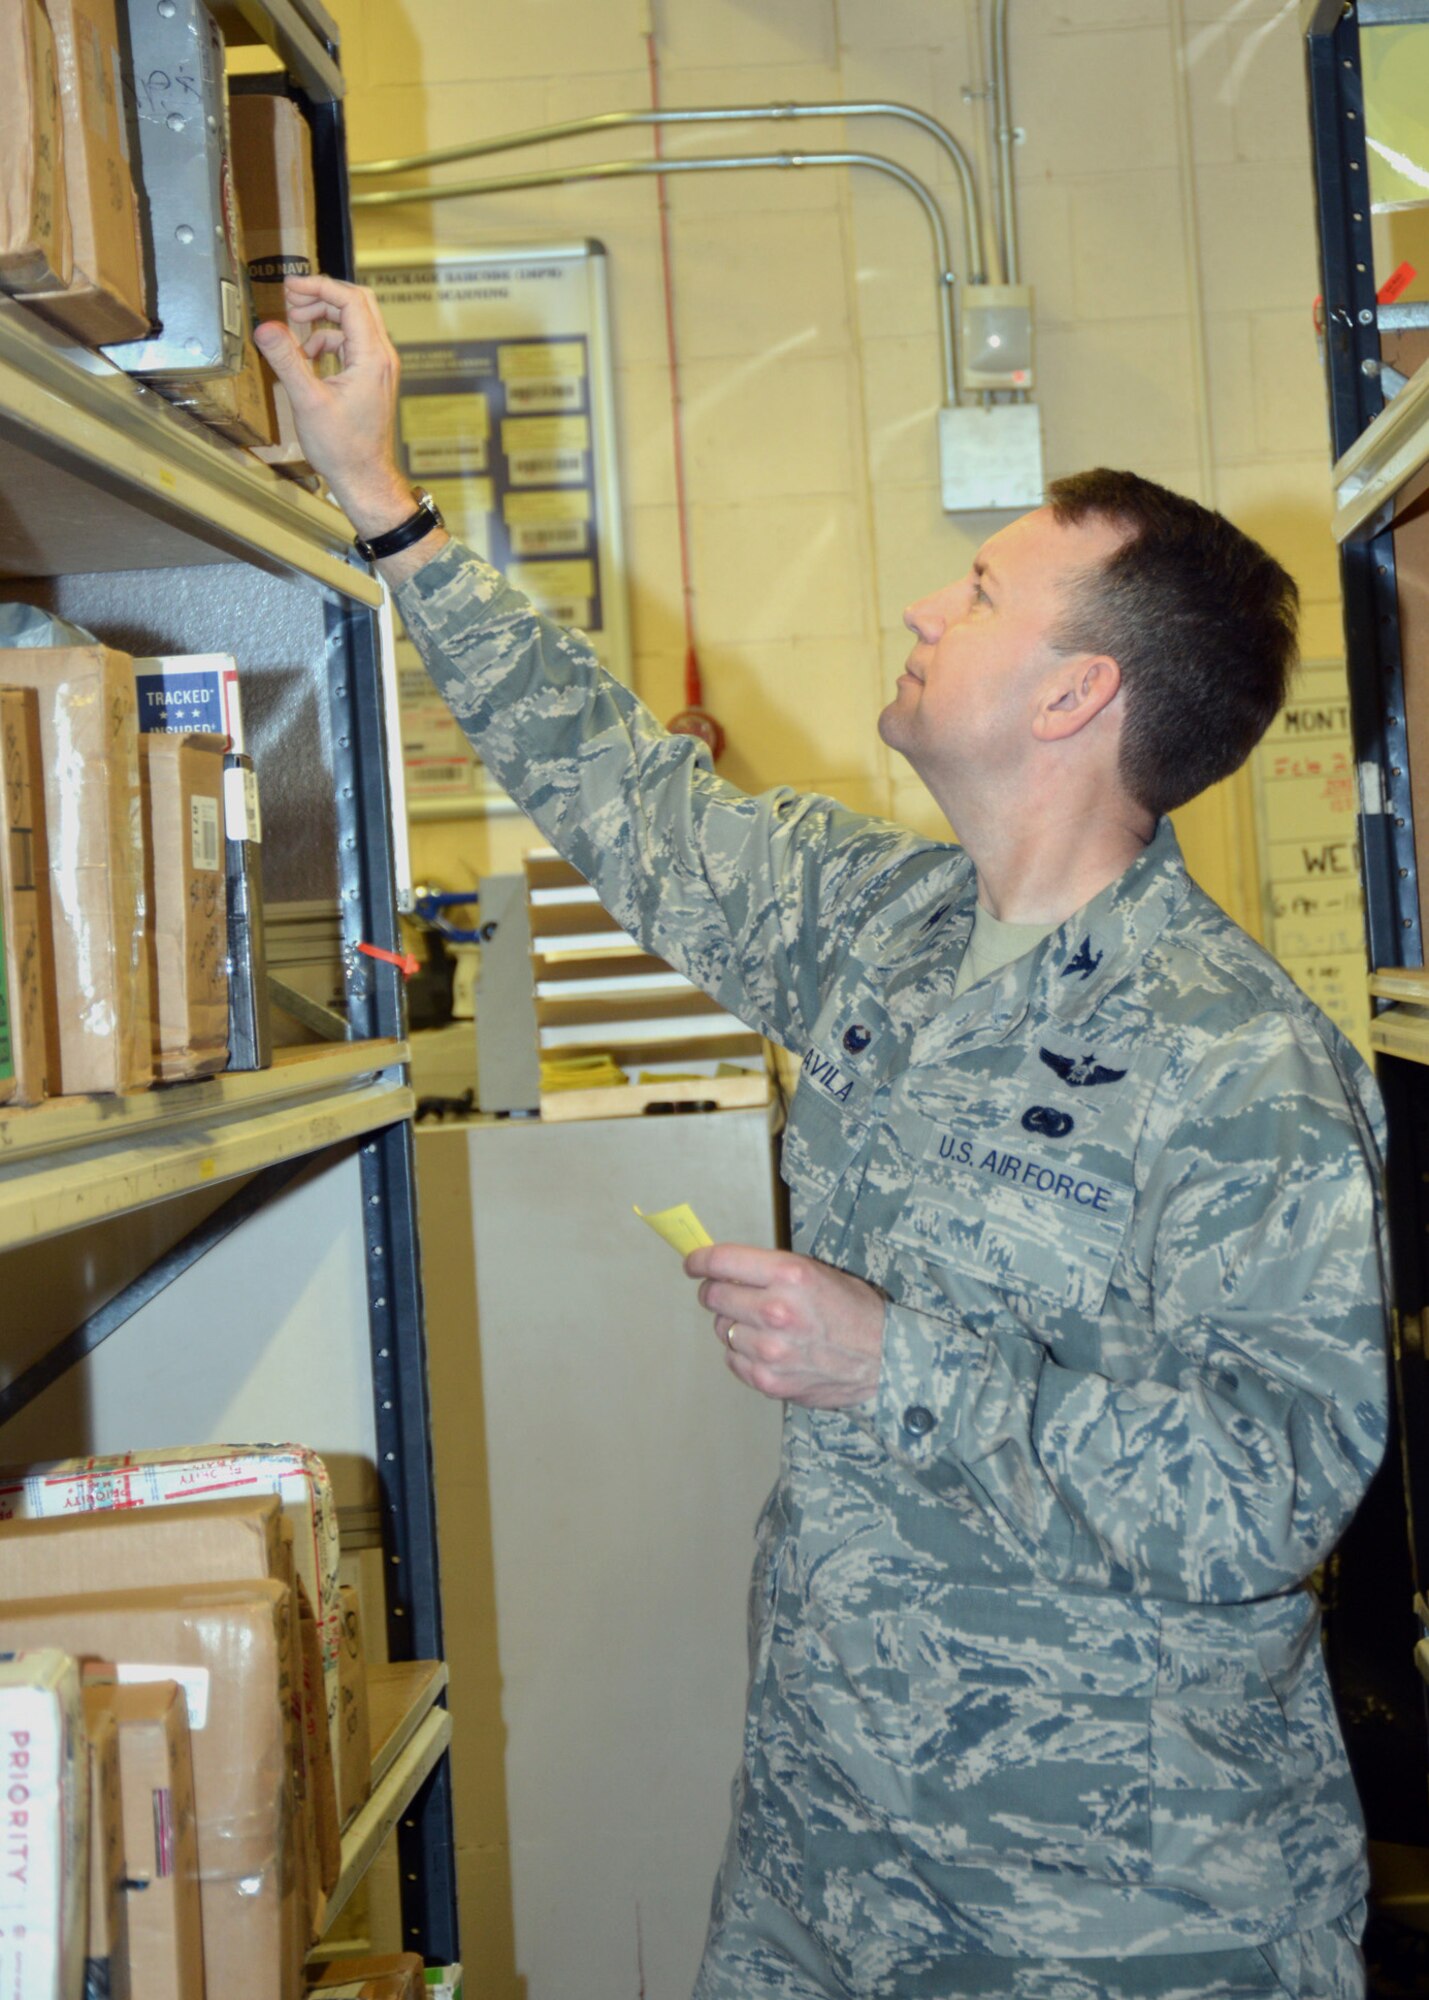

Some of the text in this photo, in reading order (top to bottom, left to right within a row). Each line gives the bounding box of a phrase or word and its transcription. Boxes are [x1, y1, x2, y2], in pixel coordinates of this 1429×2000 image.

[249, 262, 310, 277] OLD NAVY
[802, 1048, 854, 1102] AVILA
[939, 1135, 1112, 1212] U.S. AIR FORCE
[8, 1730, 31, 1885] PRIORITY
